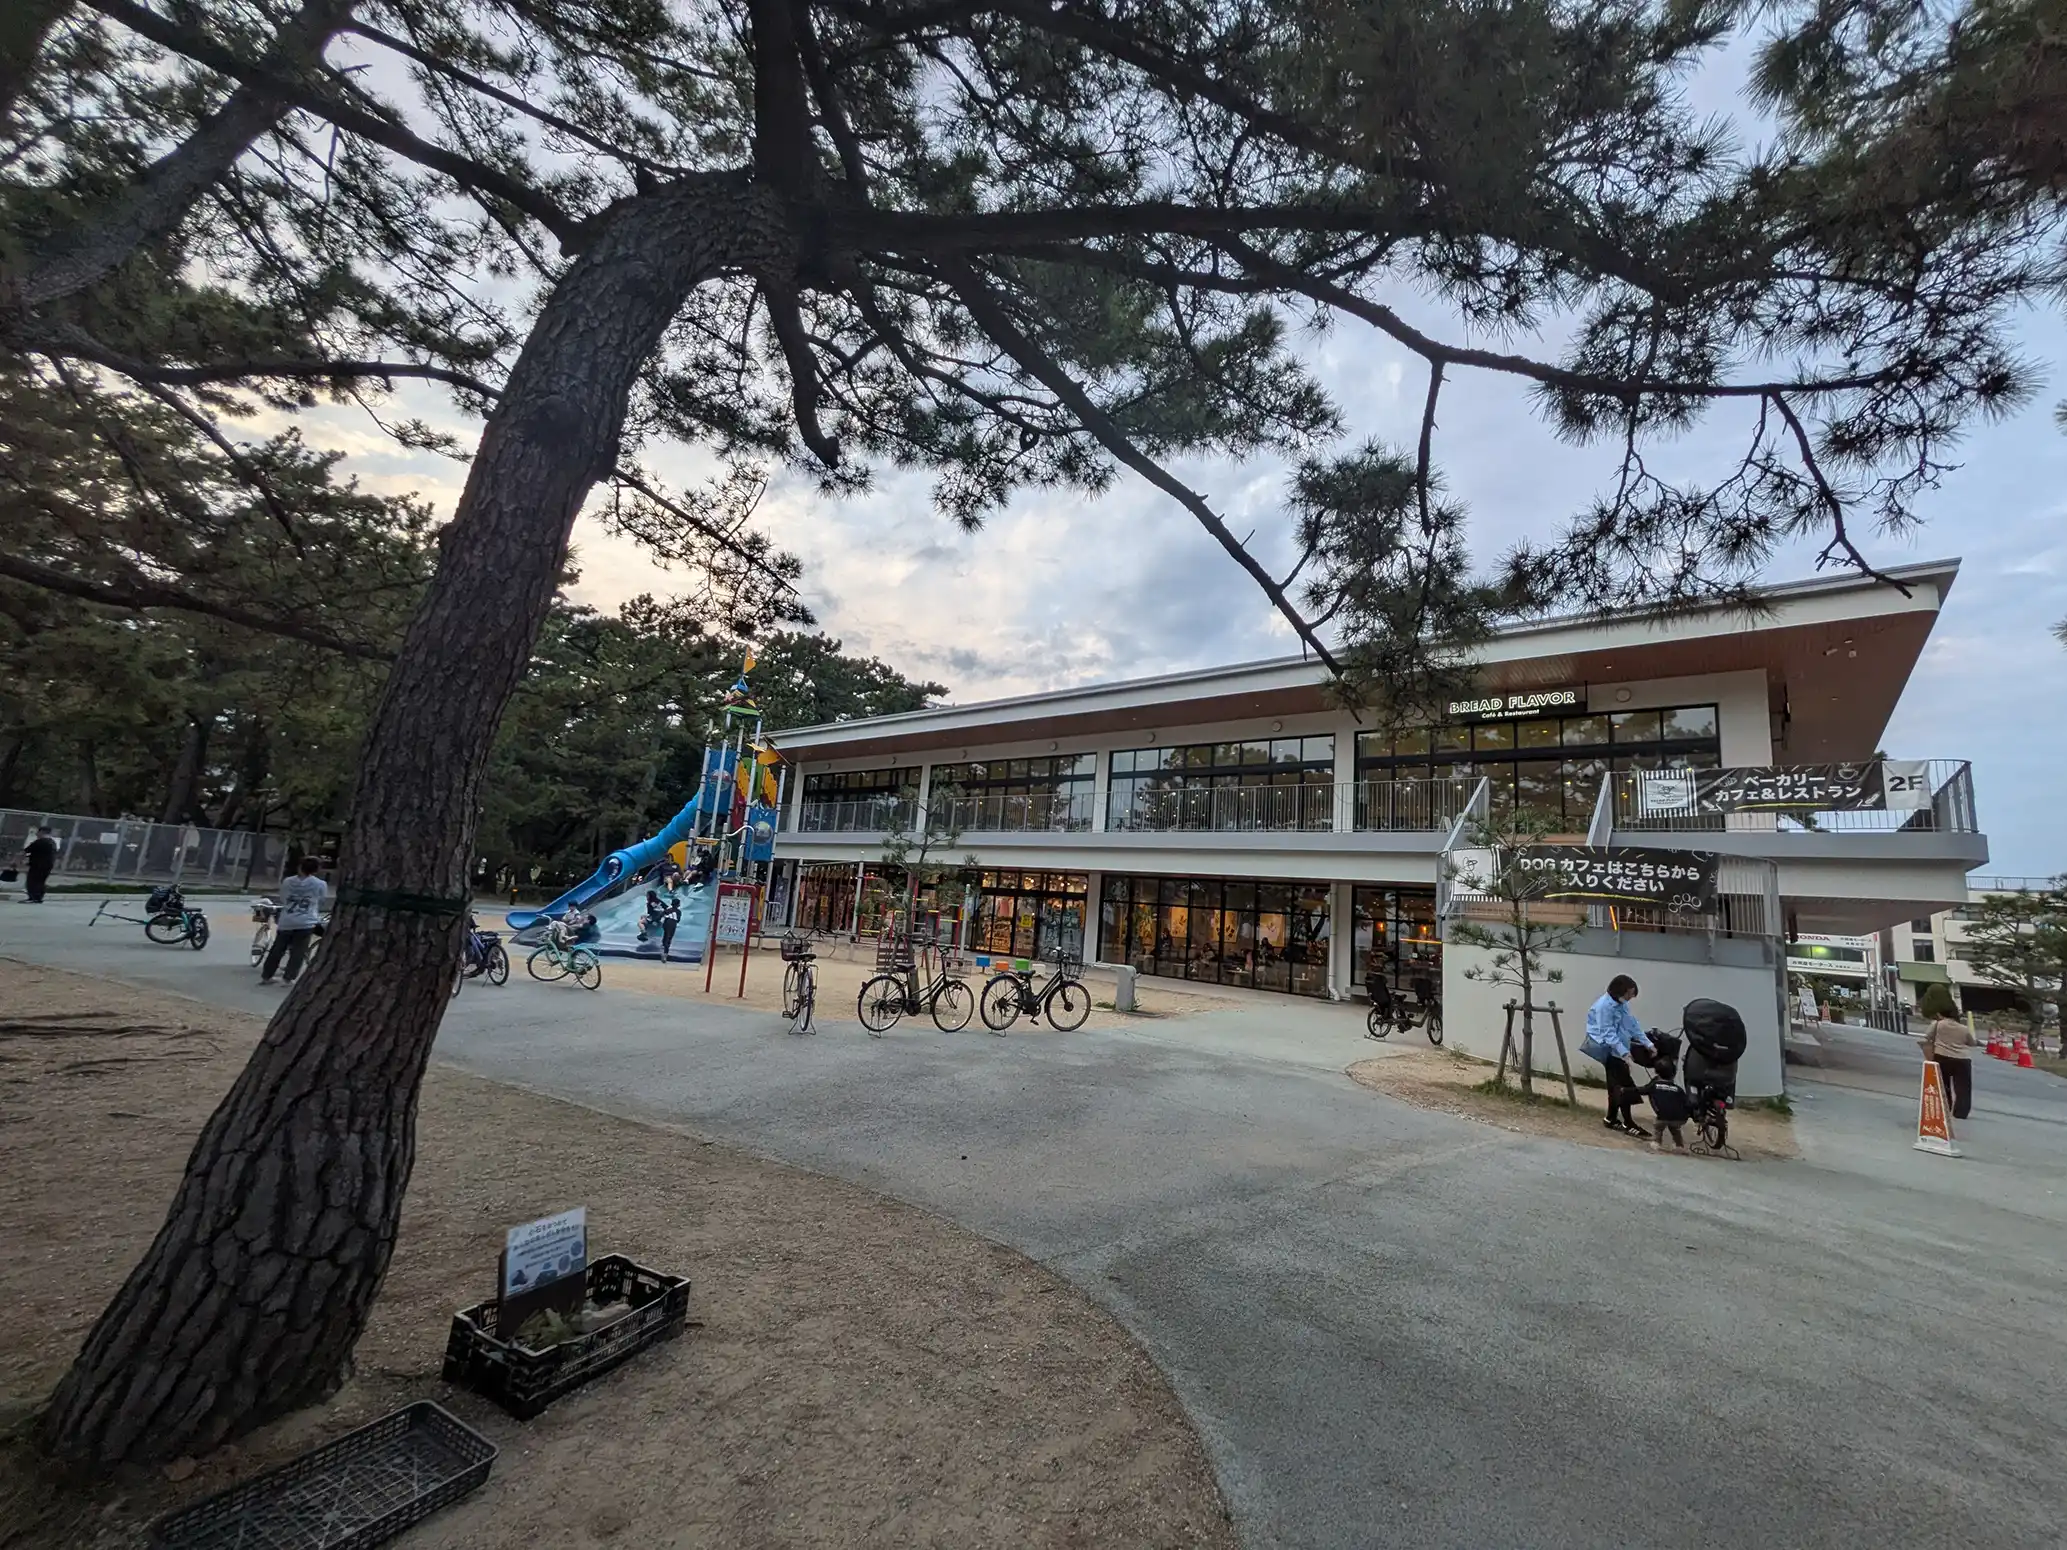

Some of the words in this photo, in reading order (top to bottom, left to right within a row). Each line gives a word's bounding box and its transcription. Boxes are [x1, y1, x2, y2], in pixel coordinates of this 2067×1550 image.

[1449, 698, 1503, 714] BREAD
[1508, 691, 1576, 709] FLAVOR
[1481, 711, 1496, 719] Café
[1504, 708, 1540, 717] Restaurant
[1743, 773, 1826, 787] ベーカリー
[1888, 775, 1924, 793] 2F
[1520, 858, 1556, 872] DOG
[1560, 858, 1700, 881] カフェはこちらから
